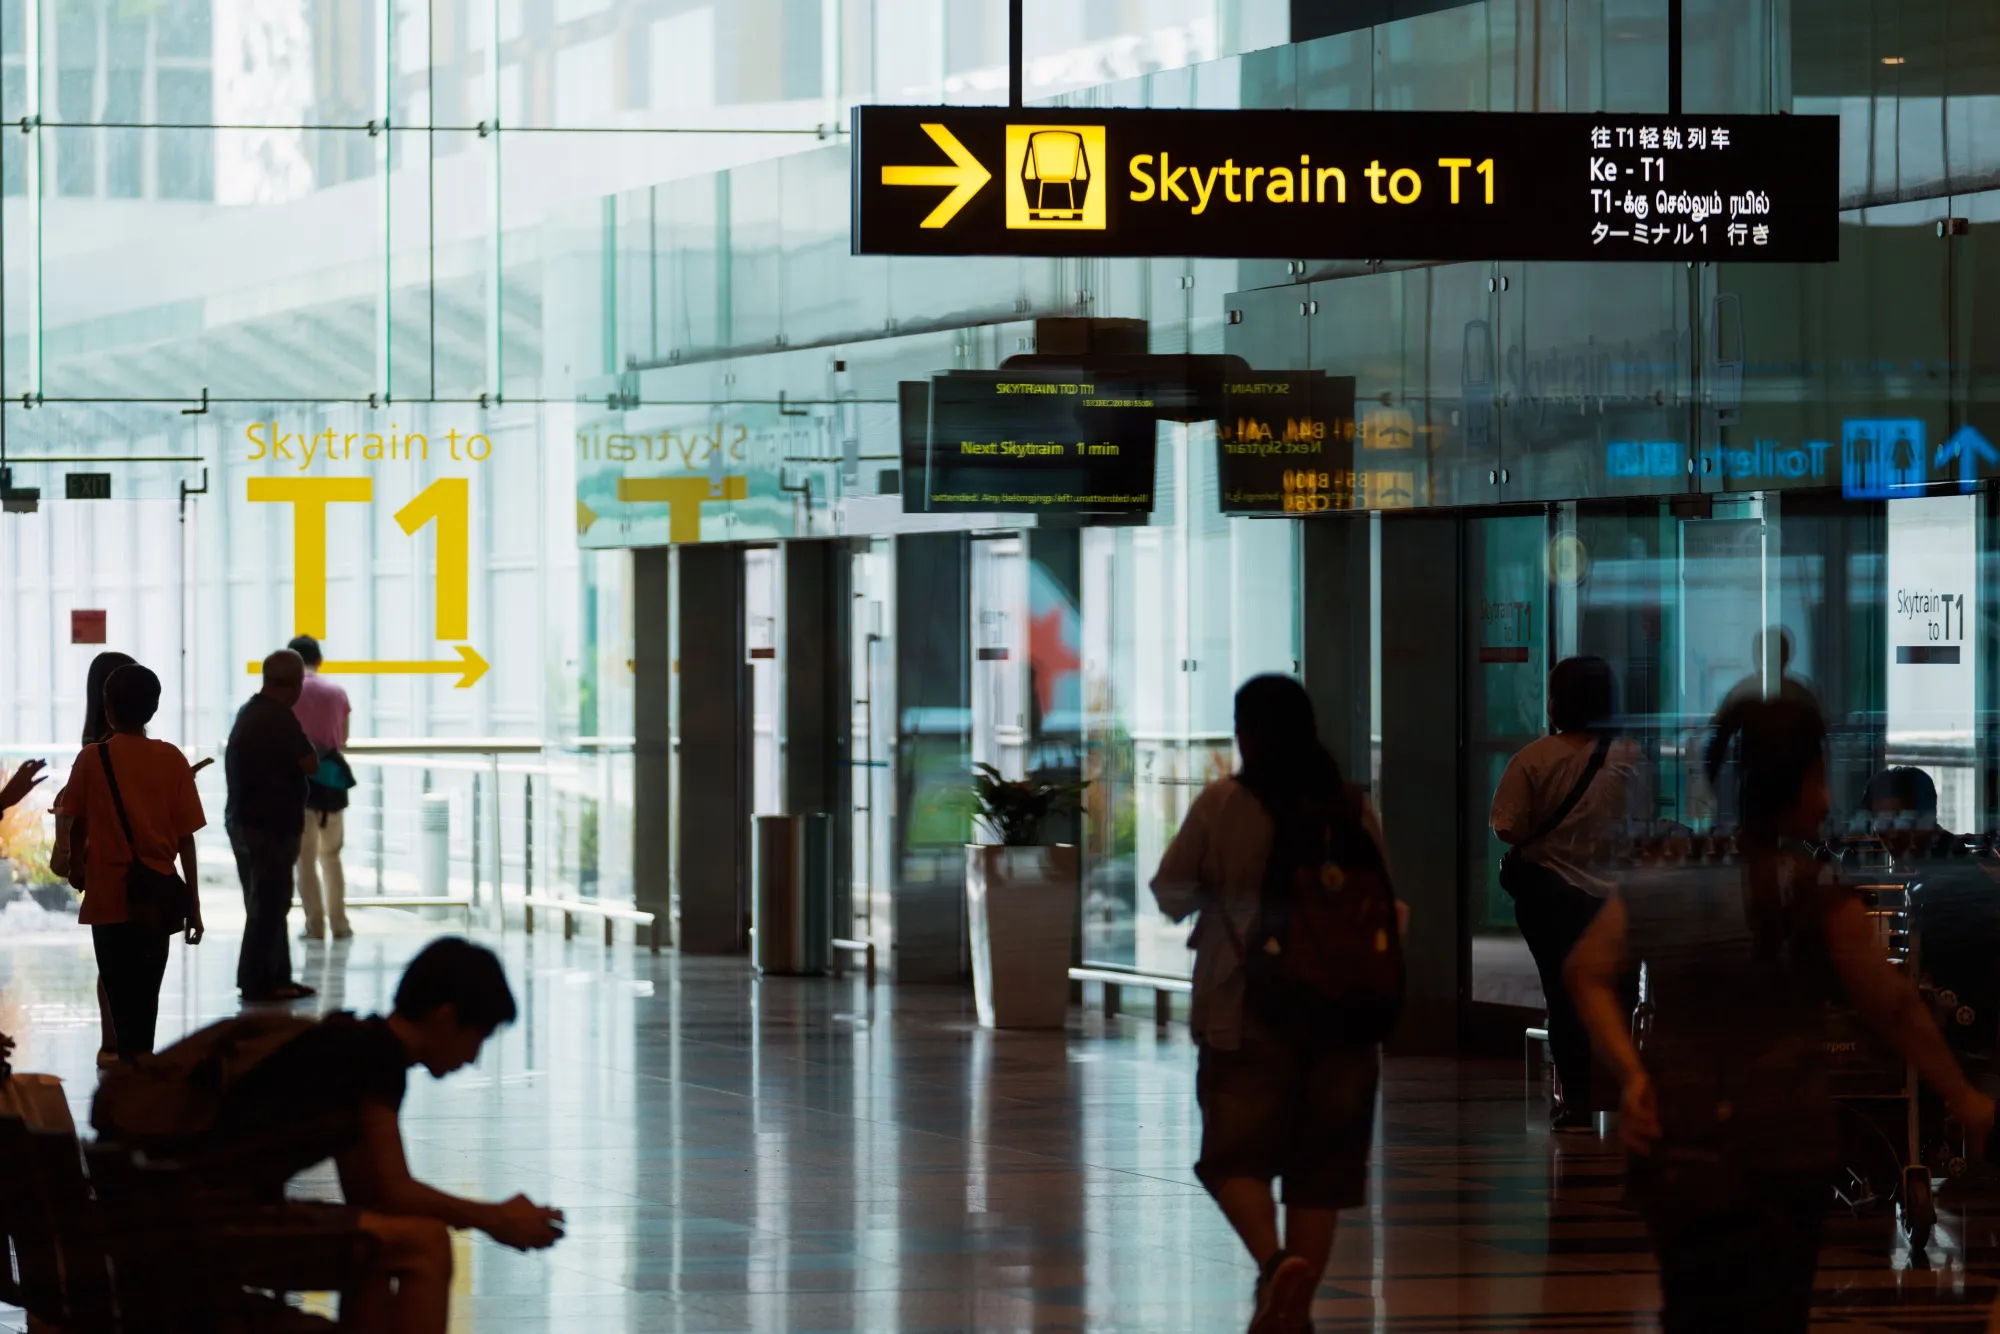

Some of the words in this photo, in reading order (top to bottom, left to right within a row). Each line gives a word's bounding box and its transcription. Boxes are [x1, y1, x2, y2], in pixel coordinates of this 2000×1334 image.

[1129, 152, 1346, 215] Skytrain
[1363, 160, 1422, 204] to
[1438, 158, 1494, 204] T1
[1590, 157, 1617, 182] Ke
[1641, 157, 1664, 182] T1
[1728, 223, 1770, 246] 行き
[246, 421, 428, 470] Skytrain
[445, 428, 492, 461] to
[961, 441, 998, 455] Next
[1000, 441, 1064, 458] Skytrain
[1088, 441, 1119, 455] min
[69, 475, 107, 497] EXIT
[247, 477, 469, 640] T1
[1898, 588, 1940, 620] Skytrain
[1941, 594, 1963, 640] T1
[1928, 619, 1940, 640] to
